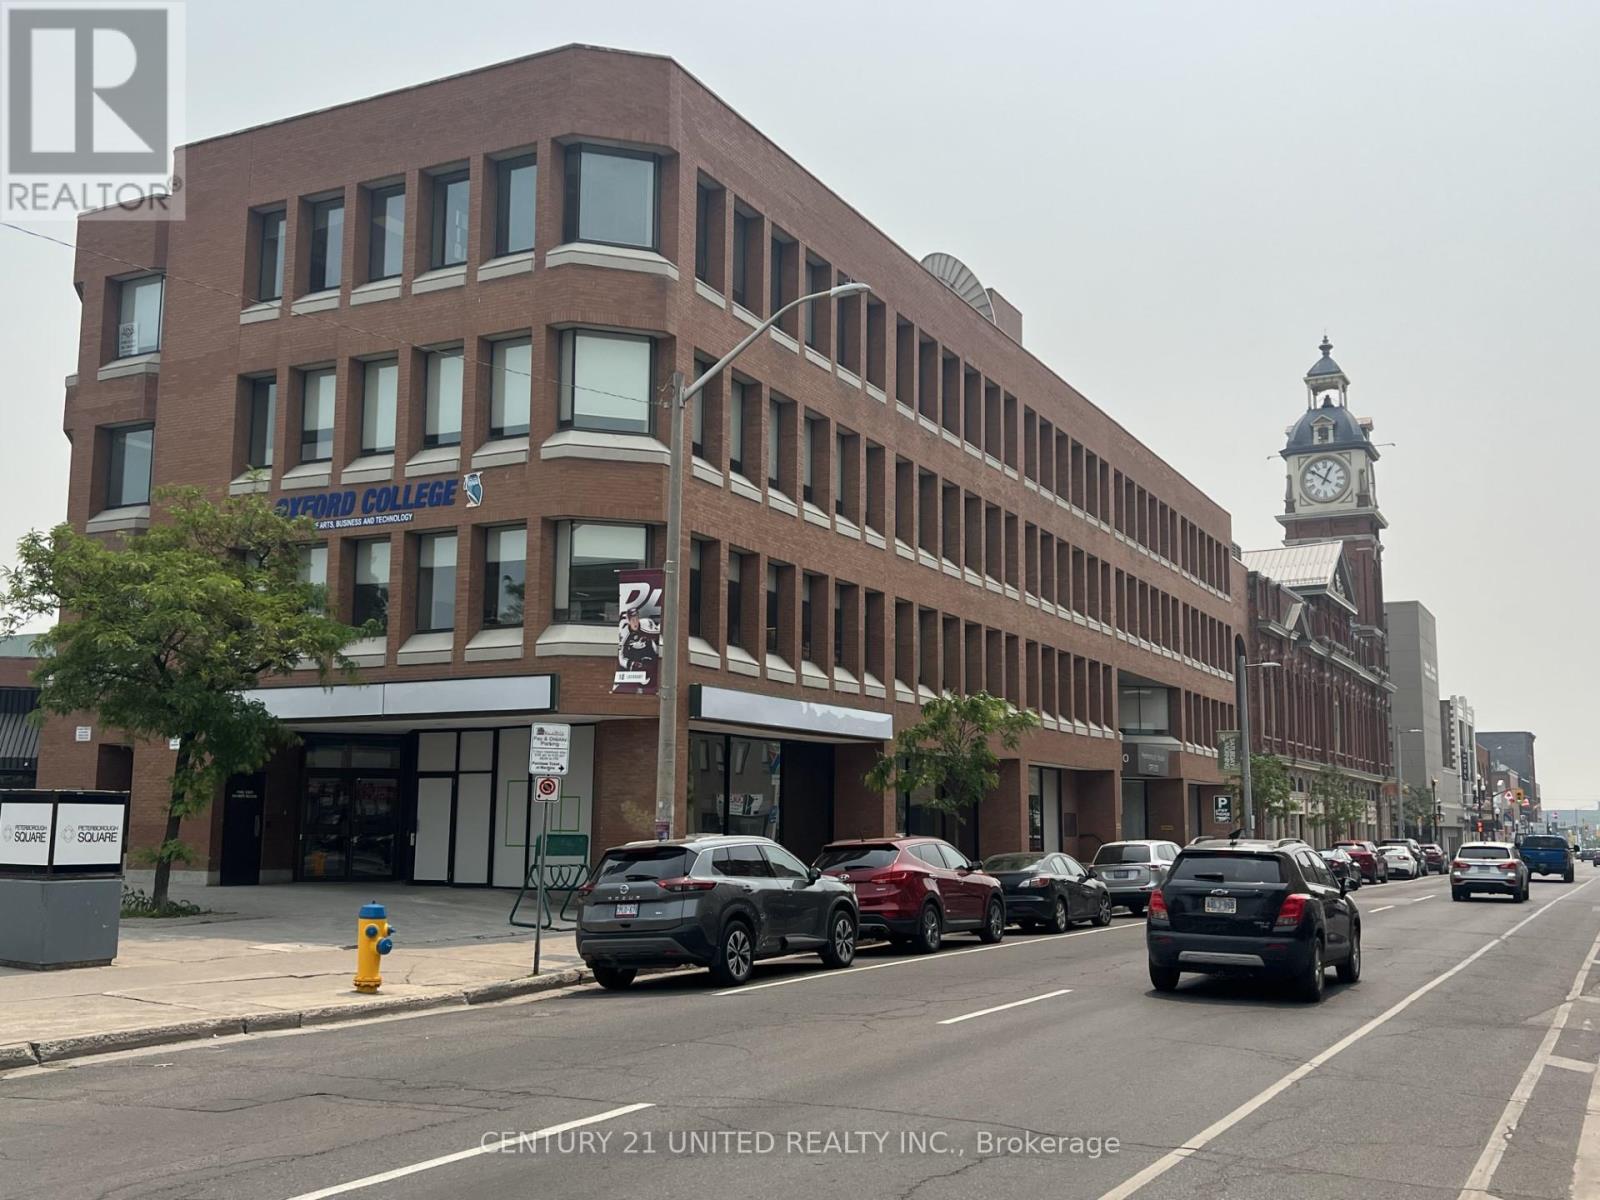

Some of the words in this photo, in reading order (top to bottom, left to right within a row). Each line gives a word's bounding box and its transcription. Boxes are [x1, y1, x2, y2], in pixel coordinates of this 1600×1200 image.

[361, 479, 459, 514] COLLEGE
[319, 521, 334, 529] ARTS,
[335, 518, 362, 528] BUSINESS
[363, 516, 375, 525] AND
[376, 513, 413, 524] TECHNOLOGY
[1218, 797, 1228, 808] P
[14, 831, 47, 843] SQUARE
[77, 831, 119, 843] SQUARE
